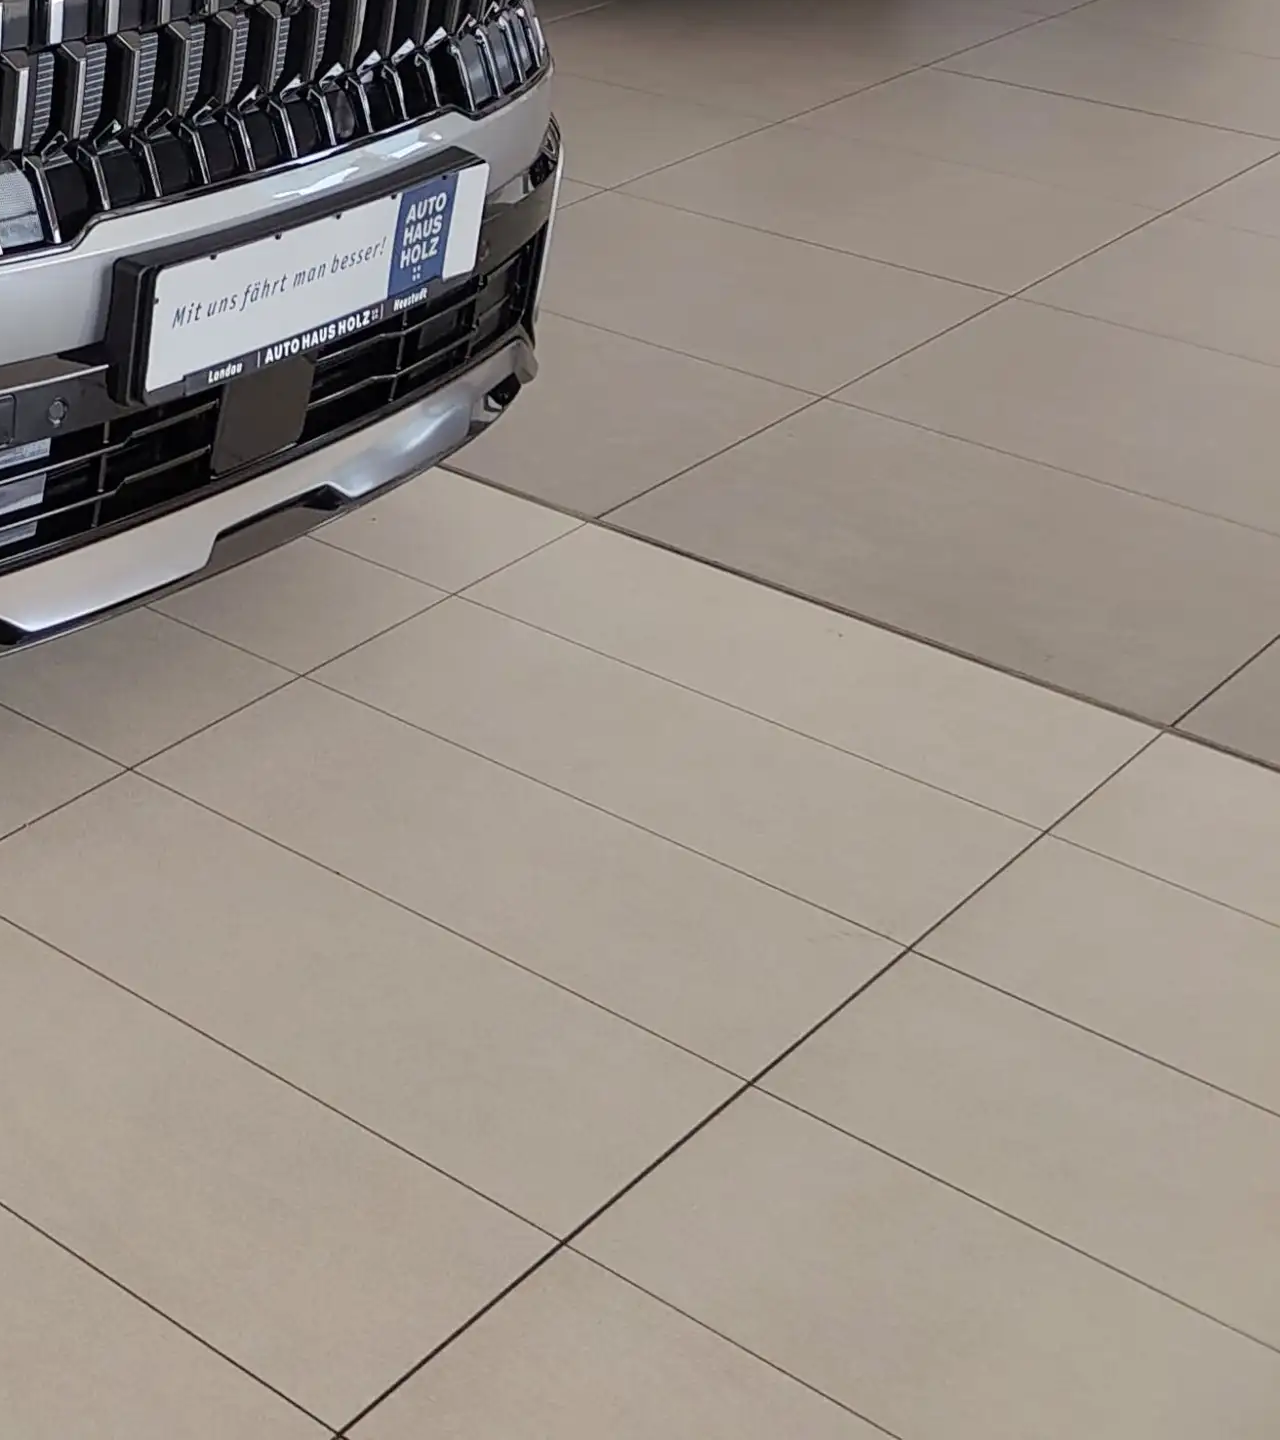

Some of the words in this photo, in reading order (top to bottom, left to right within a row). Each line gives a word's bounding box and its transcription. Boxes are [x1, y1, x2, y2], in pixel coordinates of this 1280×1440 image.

[406, 192, 447, 224] AUTO
[403, 214, 443, 246] HAUS
[400, 236, 439, 269] HOLZ
[172, 302, 202, 329] Mit
[206, 294, 238, 318] uns
[239, 275, 288, 312] fährt
[292, 263, 327, 288] man
[330, 236, 388, 274] besser!
[264, 339, 300, 364] AUTO
[301, 324, 336, 350] HAUS
[337, 309, 371, 336] HOLZ
